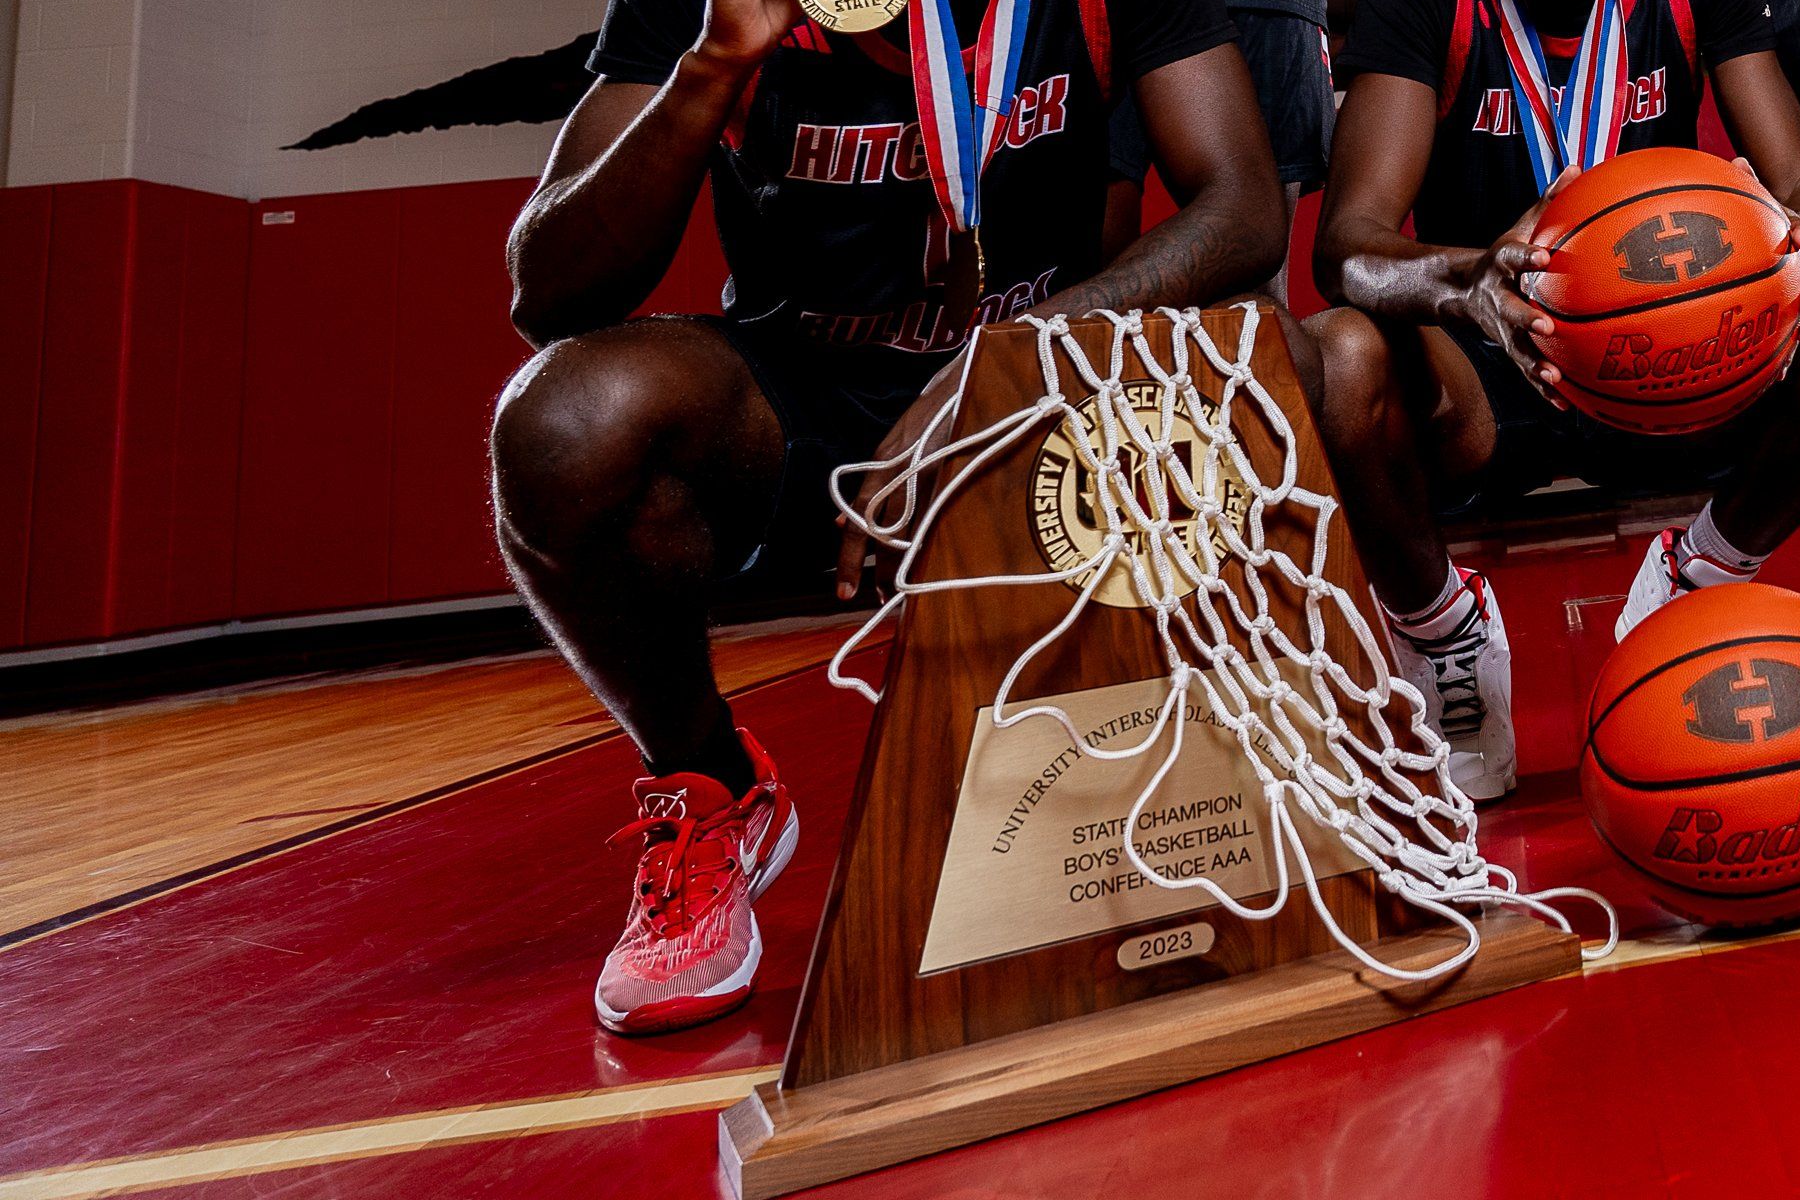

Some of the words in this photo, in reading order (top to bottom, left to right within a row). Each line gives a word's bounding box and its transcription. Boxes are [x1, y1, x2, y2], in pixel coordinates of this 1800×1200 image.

[1597, 303, 1779, 381] Baden
[992, 745, 1083, 855] UNIVERSITY
[1137, 793, 1243, 831] CHAMPION
[1064, 847, 1124, 876] BOYS'
[1135, 819, 1255, 858] BASKETBALL
[1211, 847, 1252, 871] AAA
[1140, 930, 1193, 960] 2023
